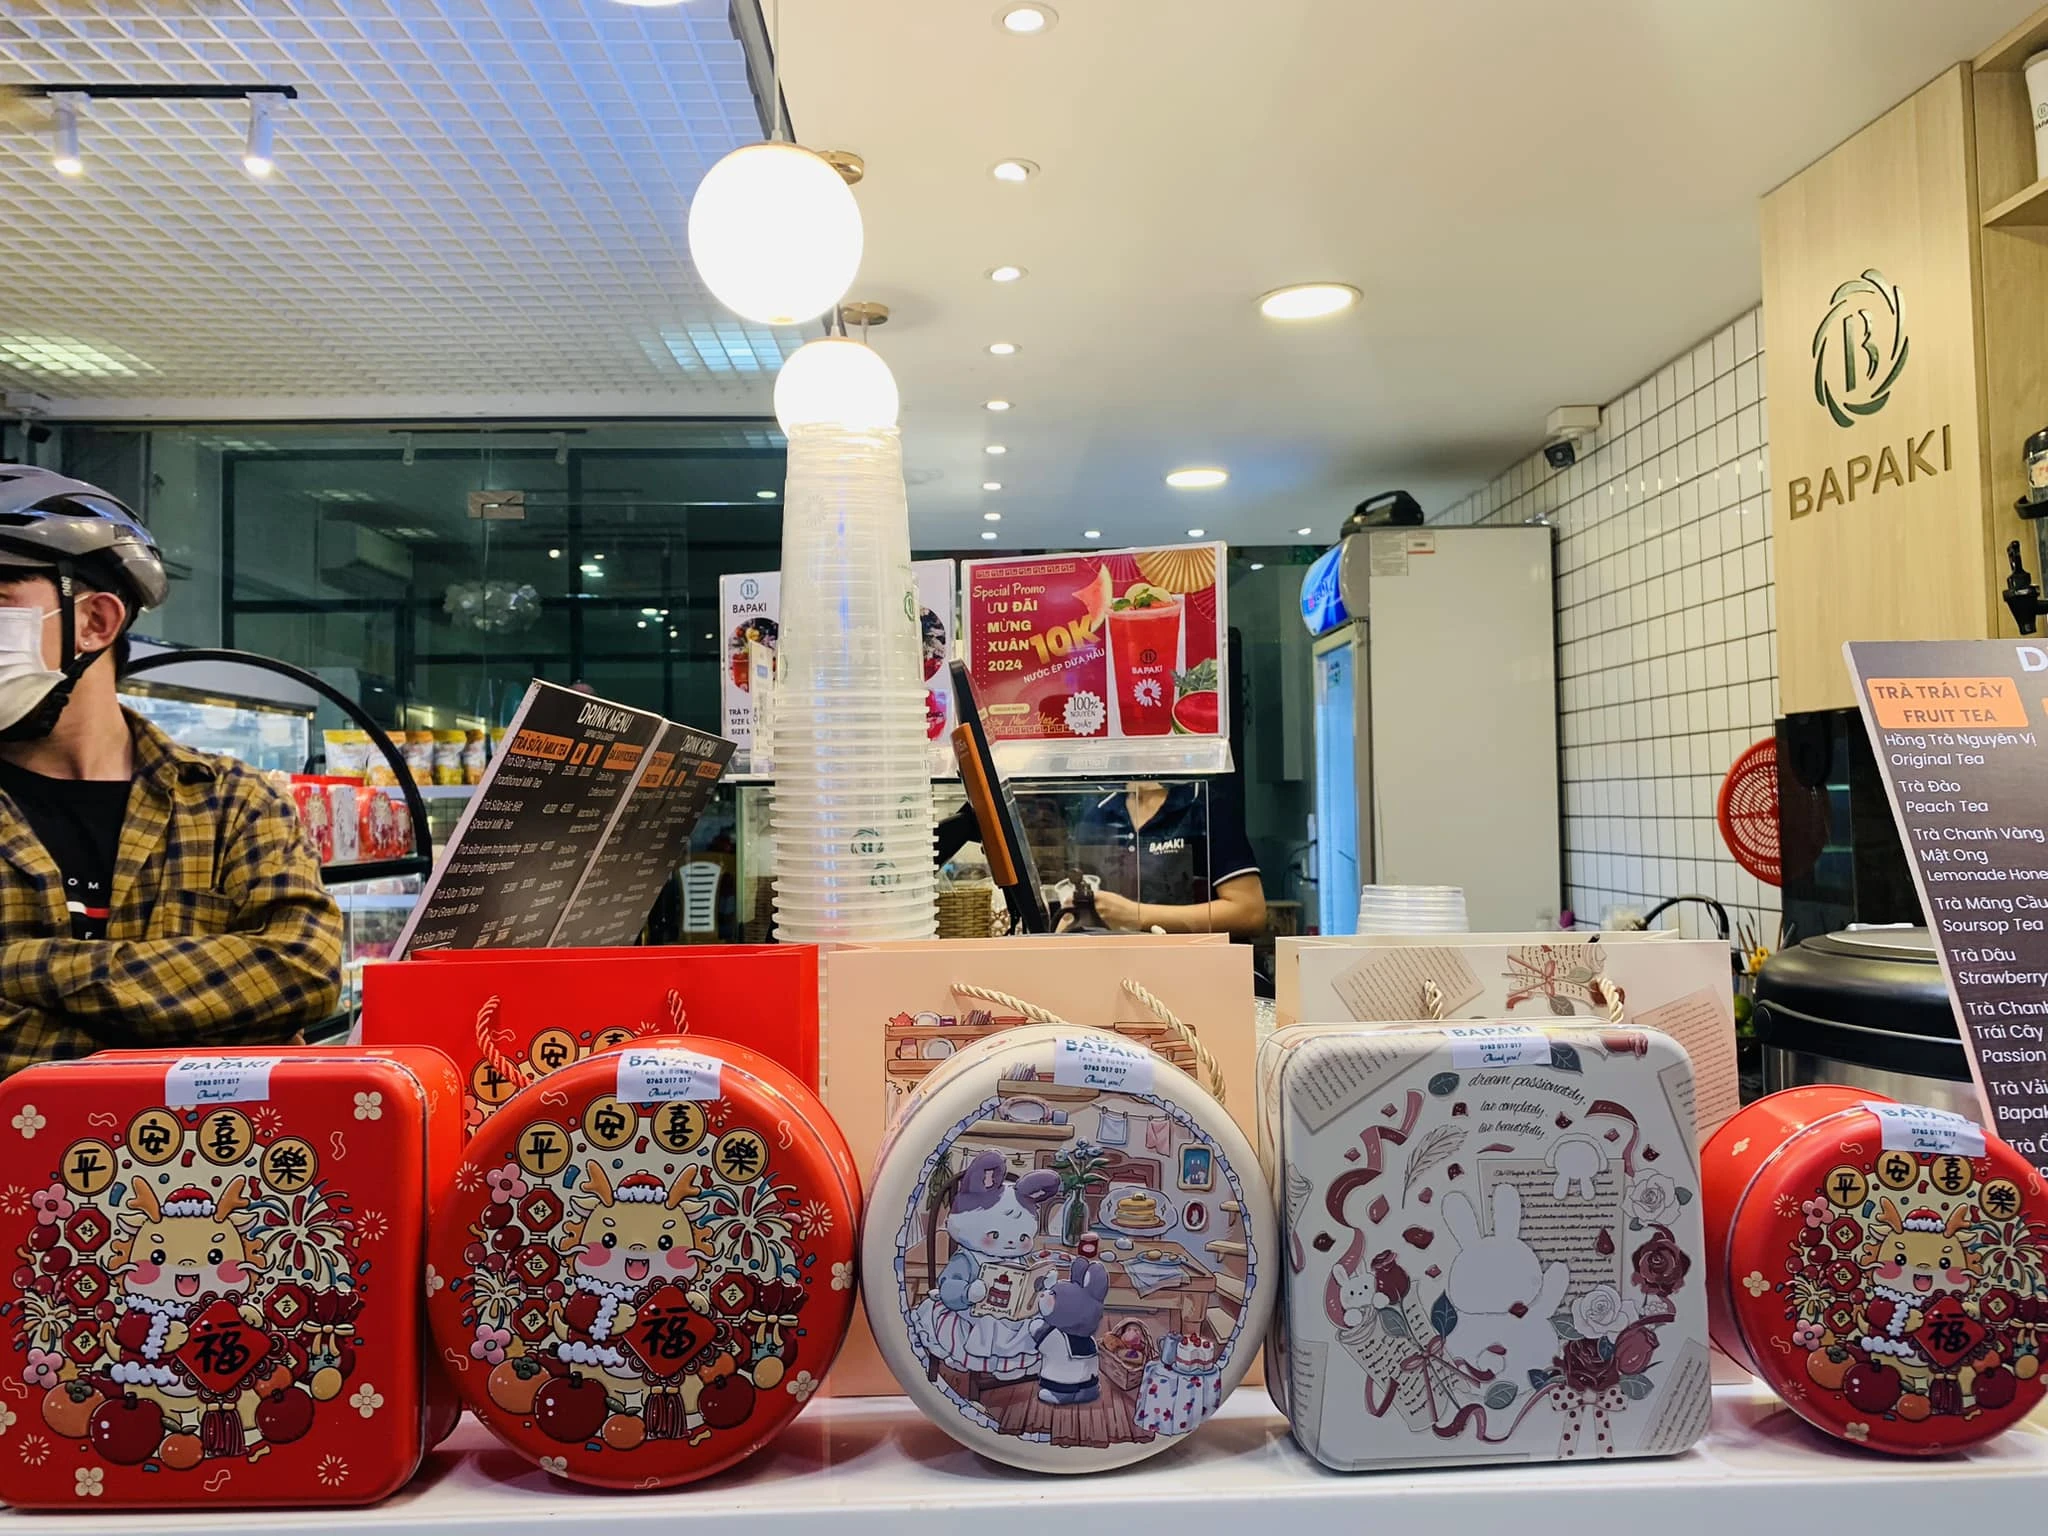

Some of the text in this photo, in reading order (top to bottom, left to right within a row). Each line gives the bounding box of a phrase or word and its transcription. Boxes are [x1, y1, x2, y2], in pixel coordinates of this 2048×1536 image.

[1788, 424, 1952, 520] BAPAKI
[973, 582, 1046, 601] Special Promo
[732, 602, 767, 614] BAPAKI
[987, 598, 1038, 614] ƯU ĐÃI
[987, 618, 1032, 633] MỪNG
[988, 638, 1030, 652] XUÂN
[1029, 614, 1101, 665] 10K
[988, 659, 1023, 672] 2024
[1131, 665, 1163, 674] BAPAKI
[1874, 682, 2004, 699] TRÀ TRÁI CÂY
[1073, 697, 1099, 711] 100%
[577, 703, 634, 733] DRINK MENU
[1903, 709, 1998, 723] FRUIT TEA
[513, 732, 530, 749] TRÀ
[542, 741, 558, 754] MILK
[556, 744, 569, 755] TEA
[1884, 731, 2037, 749] Hồng Trà Nguyên Vị
[1891, 753, 1985, 768] Original Tea
[1898, 780, 1961, 793] Trà Đào
[1906, 800, 1989, 813] Peach Tea
[1913, 825, 2045, 843] Trà Chanh Vàng
[1149, 838, 1184, 852] BAPAKI
[1920, 848, 1989, 865] Mật Ong
[1926, 868, 2048, 882] Lemonade Hone
[1934, 893, 2048, 913] Trà Mãng Cầu
[1942, 918, 2044, 934] Soursop Tea
[1950, 947, 2017, 962] Trà Dâu
[1959, 970, 2048, 988] Strawberry
[1966, 1001, 1994, 1016] Trà
[1452, 1026, 1533, 1037] BAPAKI
[1974, 1023, 2044, 1041] Trái Cây
[1982, 1048, 2047, 1063] Passion
[180, 1061, 270, 1071] BAPAKI
[1468, 1072, 1511, 1087] dream
[1990, 1081, 2019, 1095] Trà
[641, 1306, 696, 1358] 福
[1928, 1312, 1971, 1350] 福
[194, 1320, 250, 1375] 福
